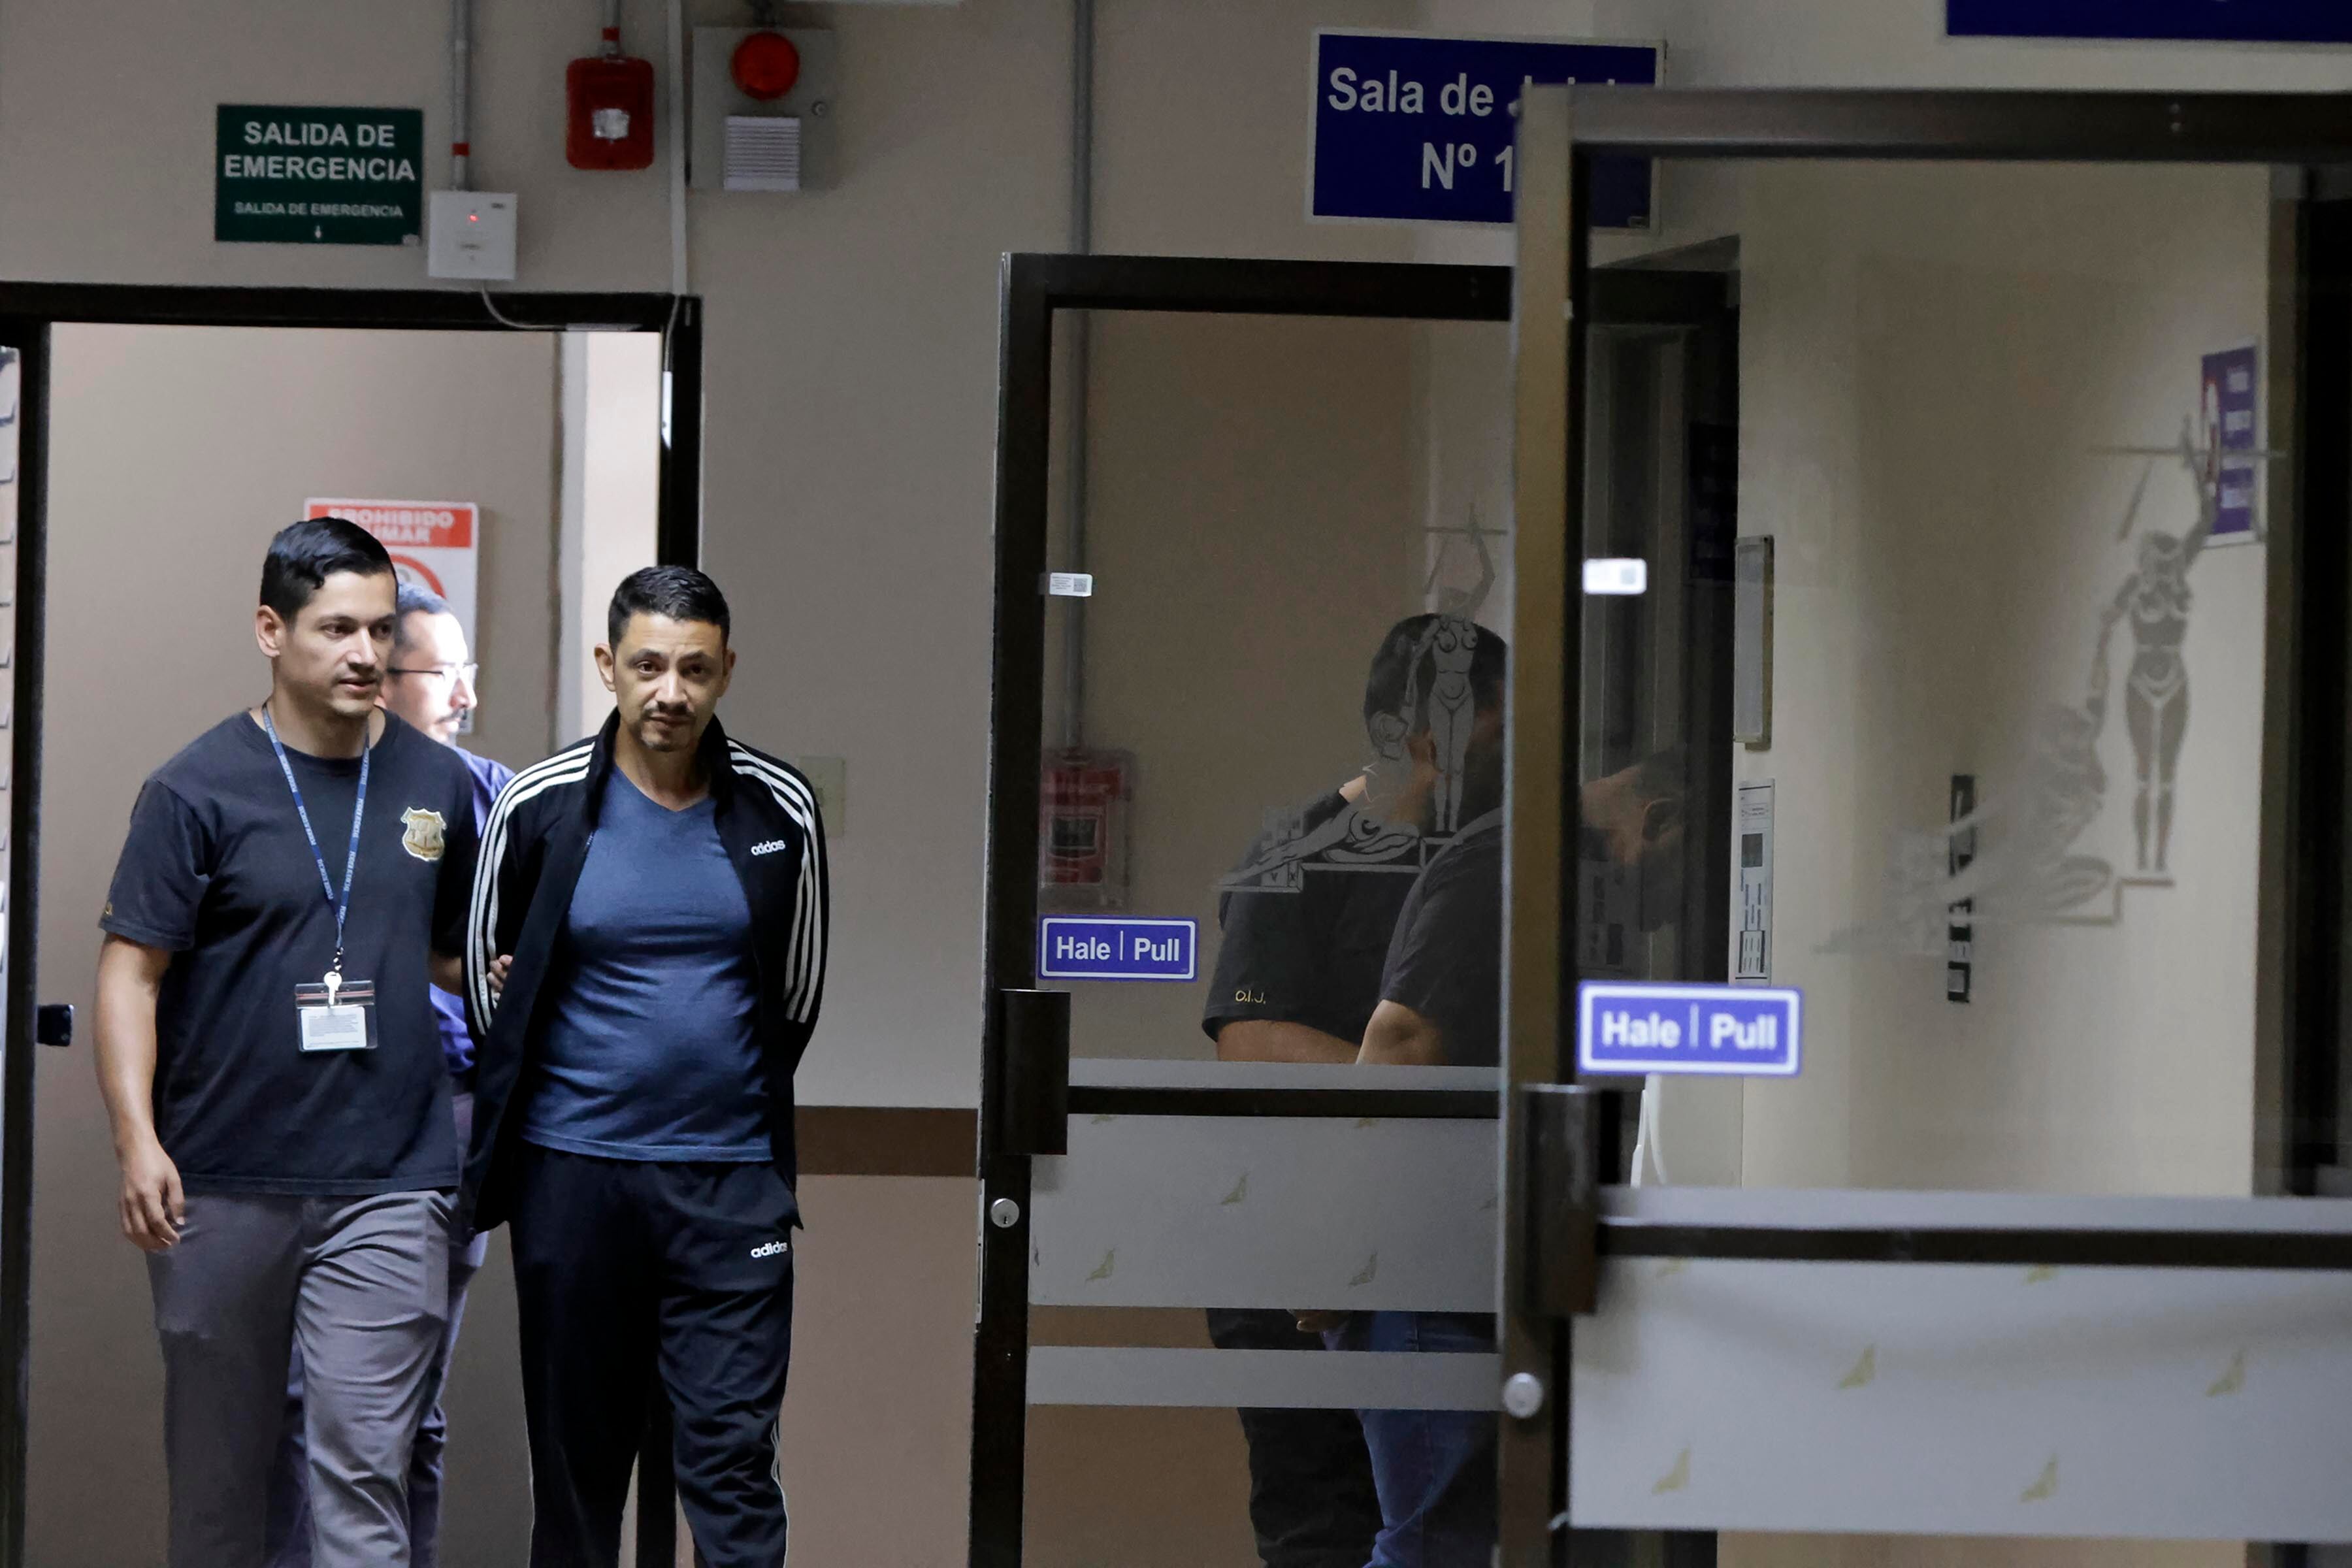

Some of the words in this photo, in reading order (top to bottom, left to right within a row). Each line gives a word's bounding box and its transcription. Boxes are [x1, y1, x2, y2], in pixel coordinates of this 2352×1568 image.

[1328, 67, 1424, 114] Sala
[1440, 73, 1494, 116] de
[244, 122, 349, 146] SALIDA
[357, 124, 395, 147] DE
[225, 155, 416, 180] EMERGENCIA
[1495, 145, 1512, 191] 1
[235, 202, 285, 214] SALIDA
[288, 203, 307, 215] DE
[310, 203, 403, 217] EMERGENCIA
[1056, 936, 1111, 960] Hale
[1134, 938, 1180, 961] Pull
[1602, 1011, 1681, 1049] Hale
[1710, 1013, 1778, 1050] Pull
